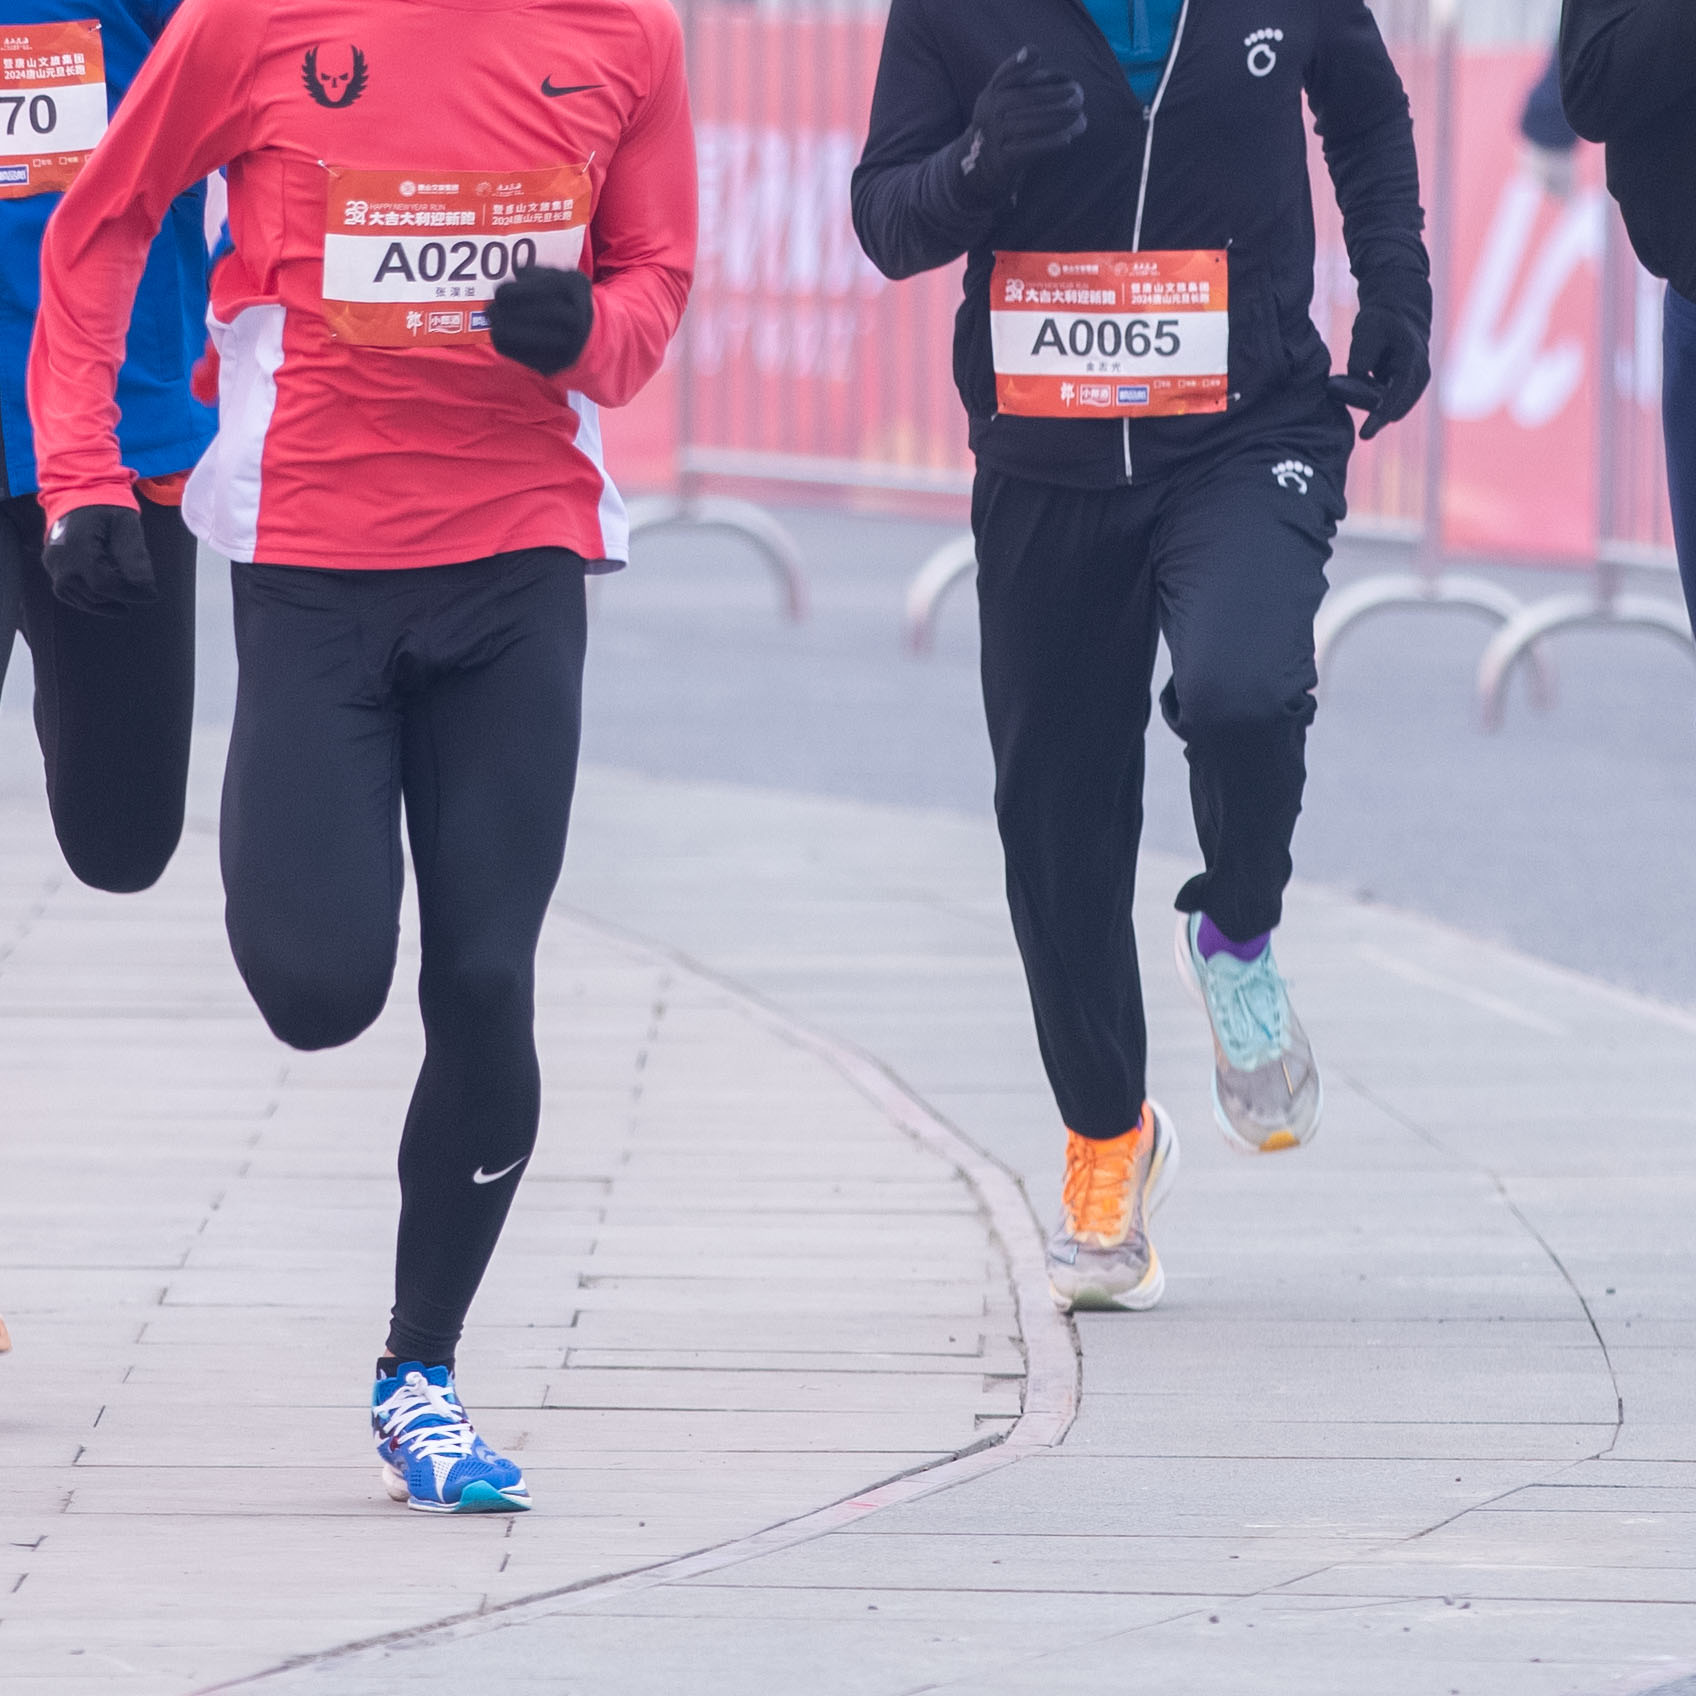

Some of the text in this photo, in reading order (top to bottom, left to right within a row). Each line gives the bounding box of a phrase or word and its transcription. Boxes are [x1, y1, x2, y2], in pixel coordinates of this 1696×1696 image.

[368, 211, 475, 226] 大吉大利迎新跑
[373, 238, 537, 283] A0200
[1030, 317, 1181, 358] A0065
